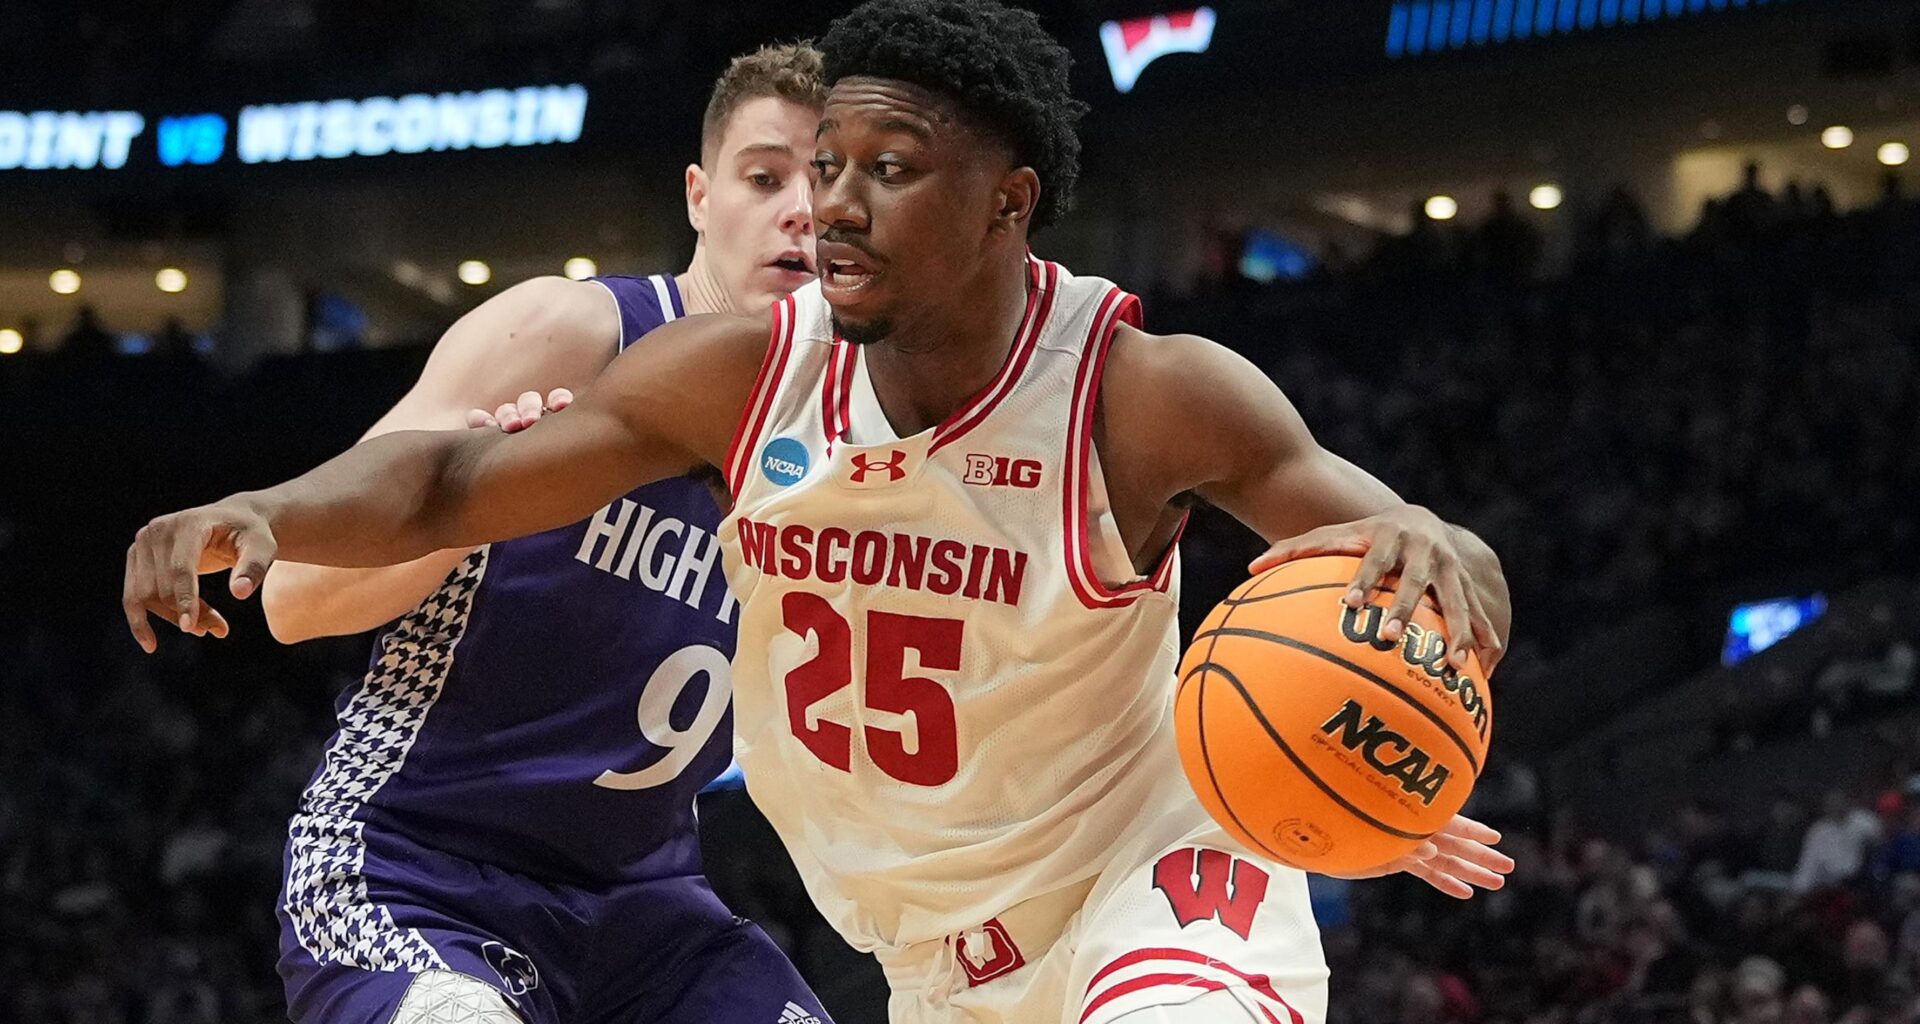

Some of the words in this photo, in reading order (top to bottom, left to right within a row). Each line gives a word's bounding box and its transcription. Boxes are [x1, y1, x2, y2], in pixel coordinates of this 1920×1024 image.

[237, 83, 589, 164] WISCONSIN
[764, 456, 804, 479] NCAA
[574, 498, 723, 610] HIGH
[737, 516, 1027, 607] WISCONSIN
[593, 644, 731, 791] 9
[782, 591, 965, 788] 25
[1320, 698, 1451, 807] NCAA
[1151, 846, 1270, 942] W
